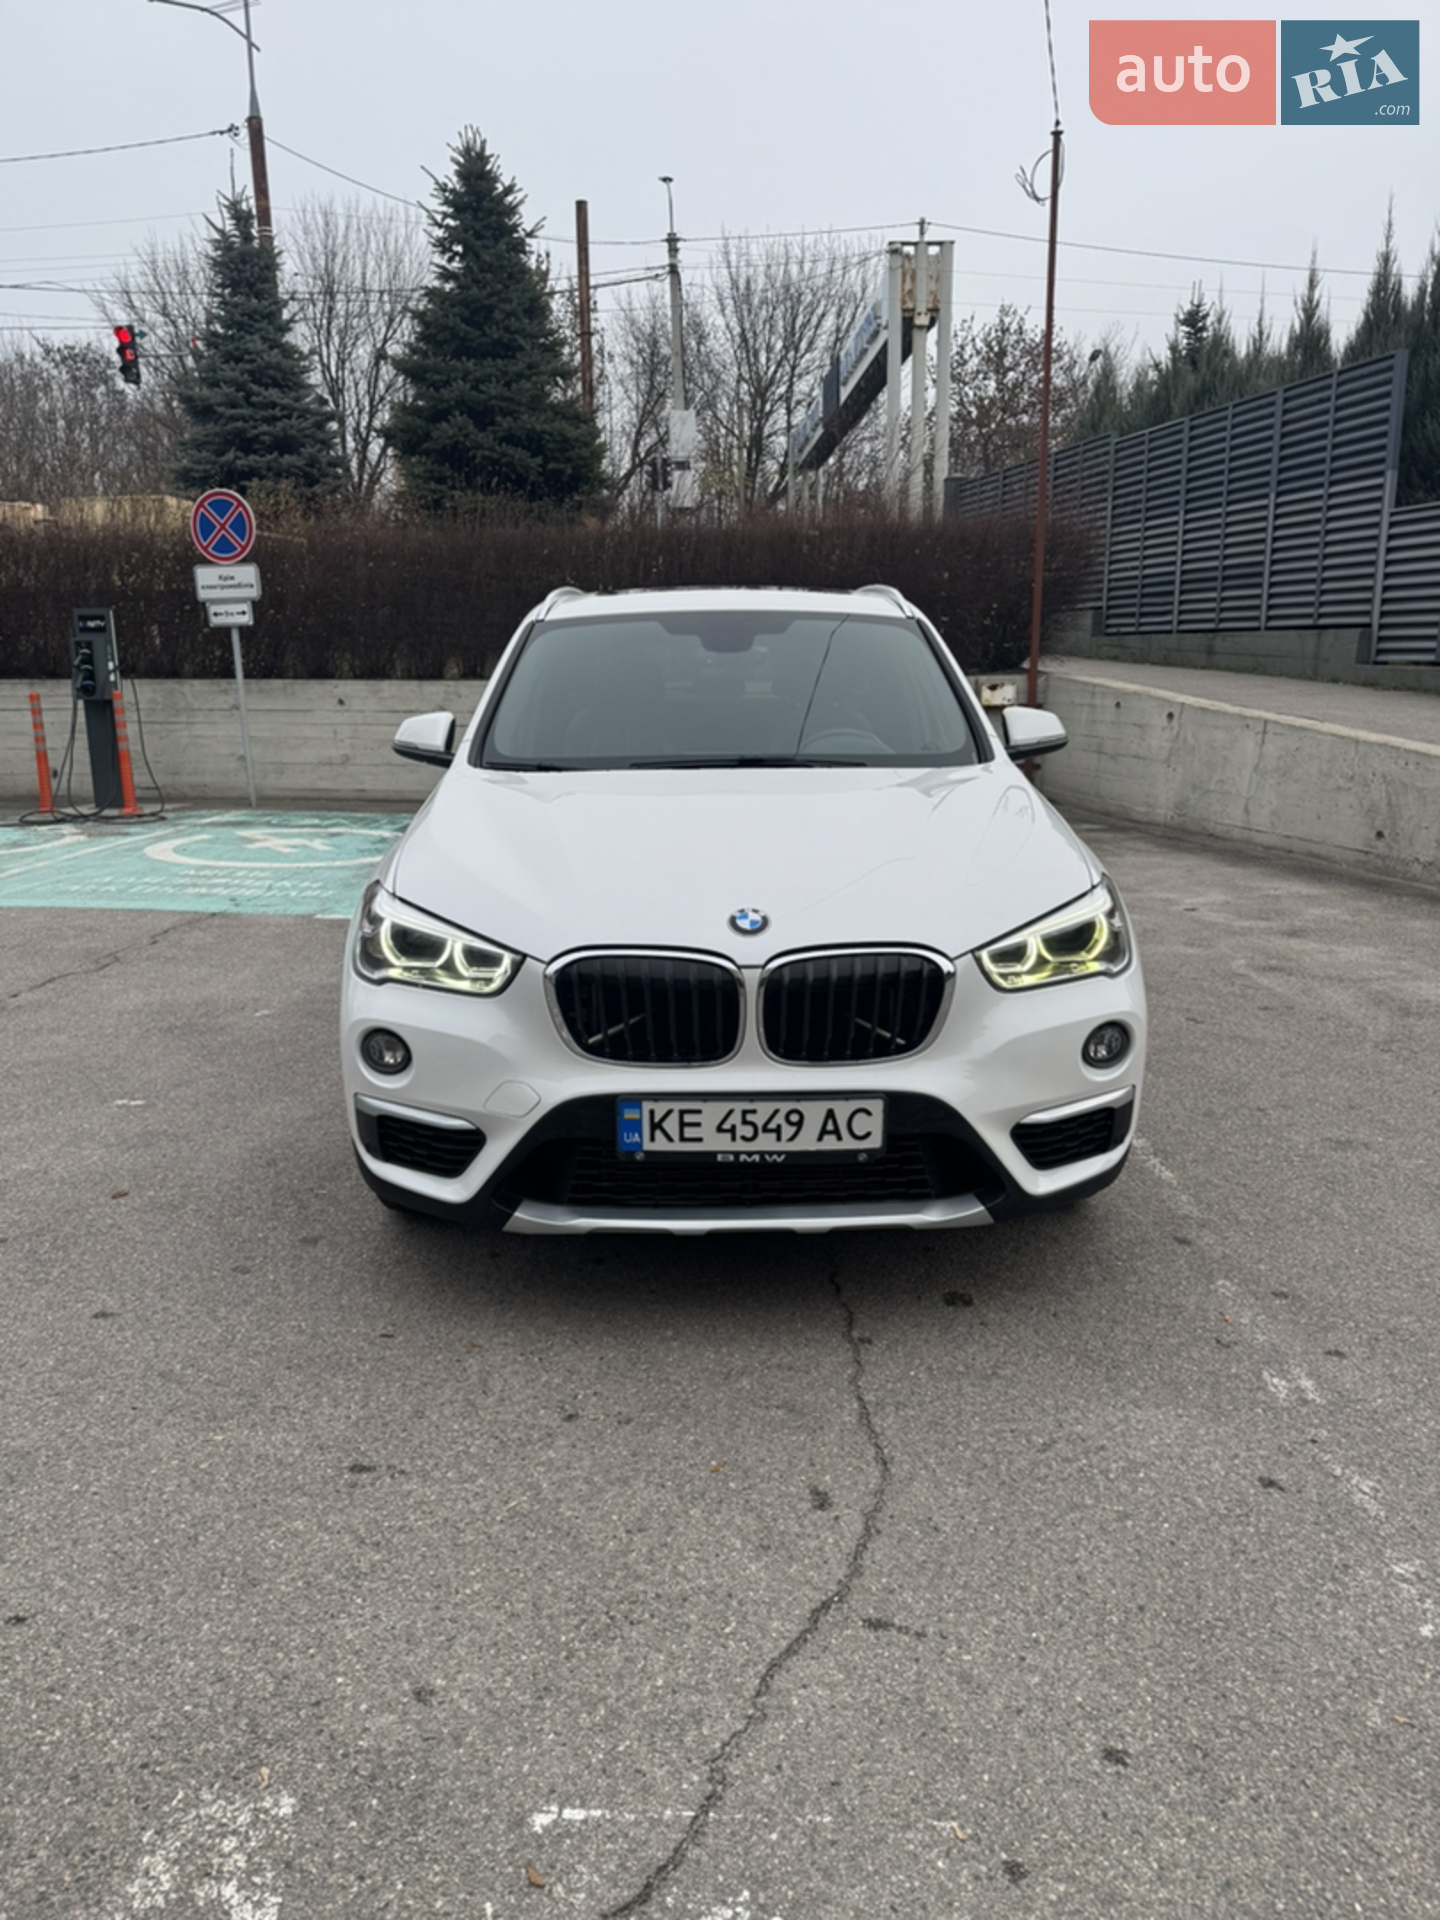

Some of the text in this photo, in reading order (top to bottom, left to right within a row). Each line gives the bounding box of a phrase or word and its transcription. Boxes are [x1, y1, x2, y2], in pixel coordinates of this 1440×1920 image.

[648, 1107, 874, 1143] KE 4549 AC
[623, 1132, 642, 1144] UA
[716, 1153, 787, 1163] BMW
